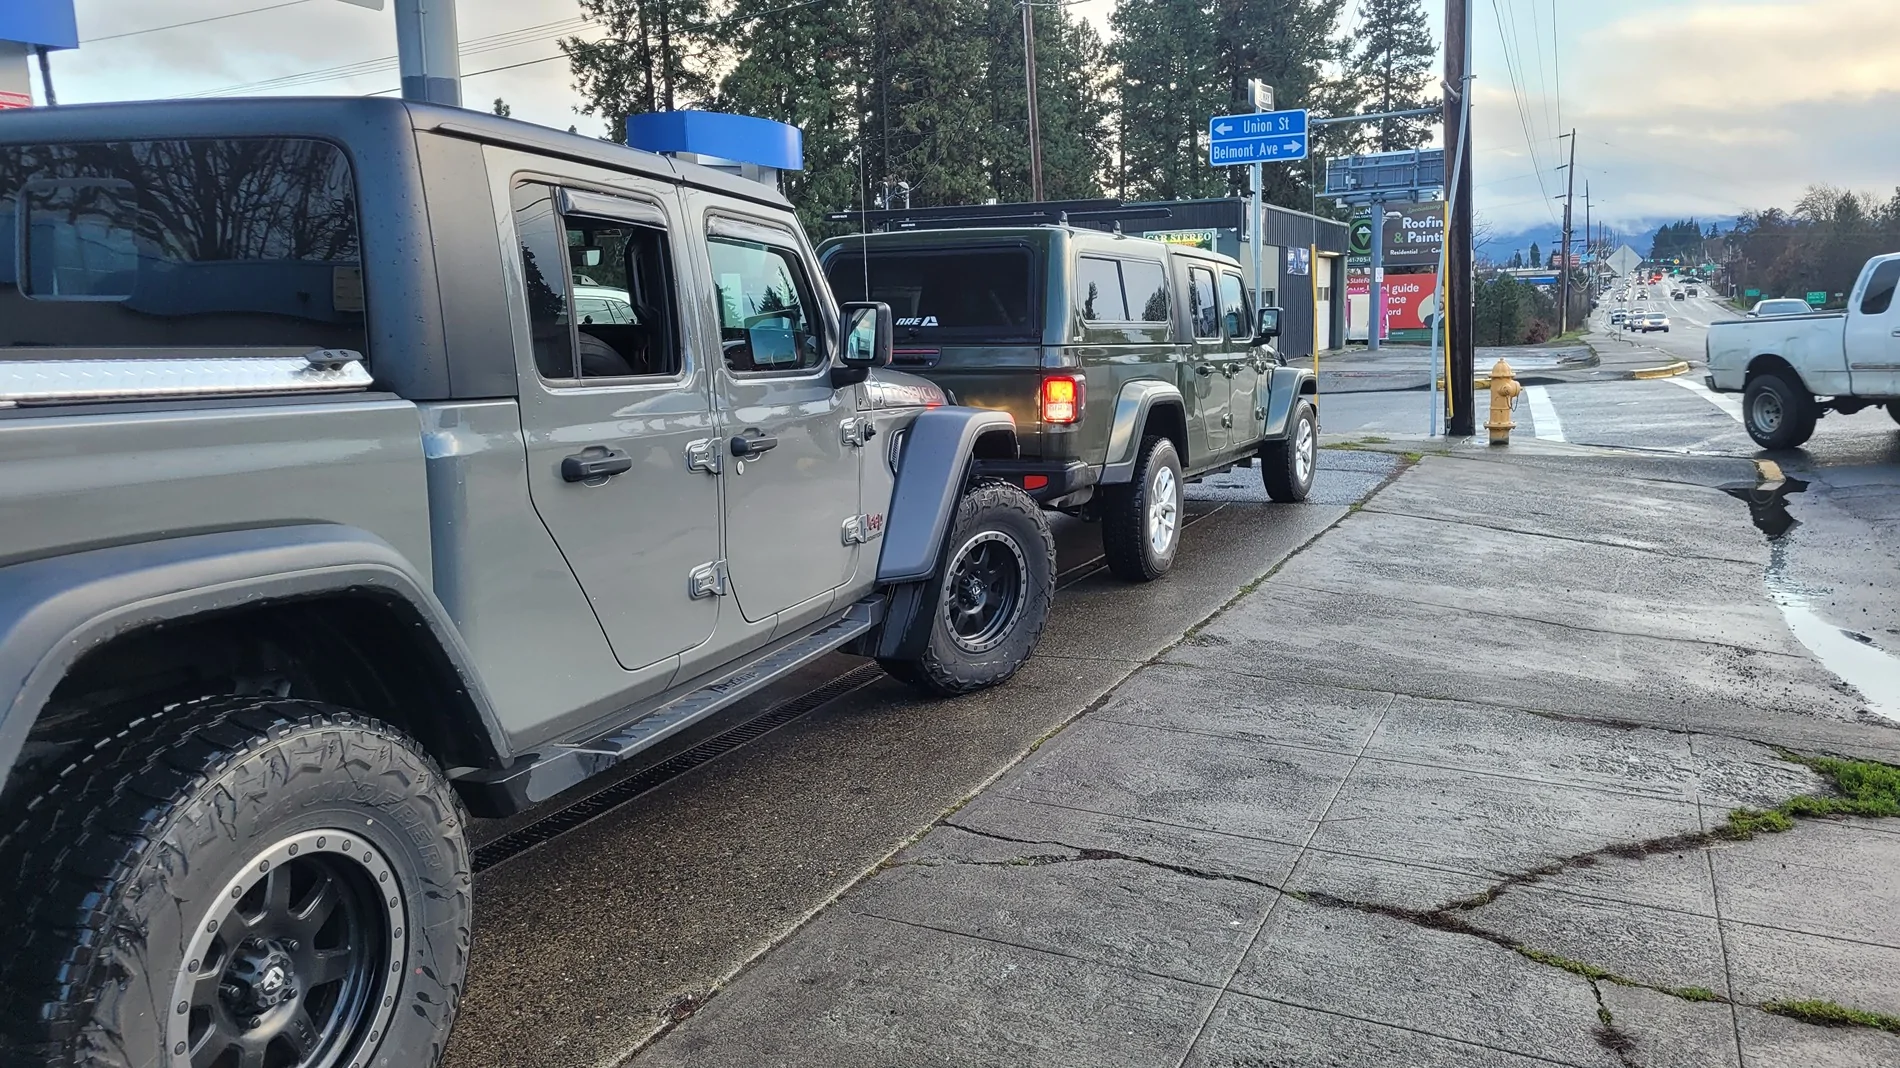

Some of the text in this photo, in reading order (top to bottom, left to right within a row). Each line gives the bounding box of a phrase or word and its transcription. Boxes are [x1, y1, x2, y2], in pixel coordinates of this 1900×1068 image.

[1243, 117, 1290, 134] Union St
[1213, 142, 1278, 160] Belmont Ave
[1402, 215, 1443, 229] Roofin
[1170, 231, 1212, 243] STEREO
[1391, 283, 1420, 295] guide
